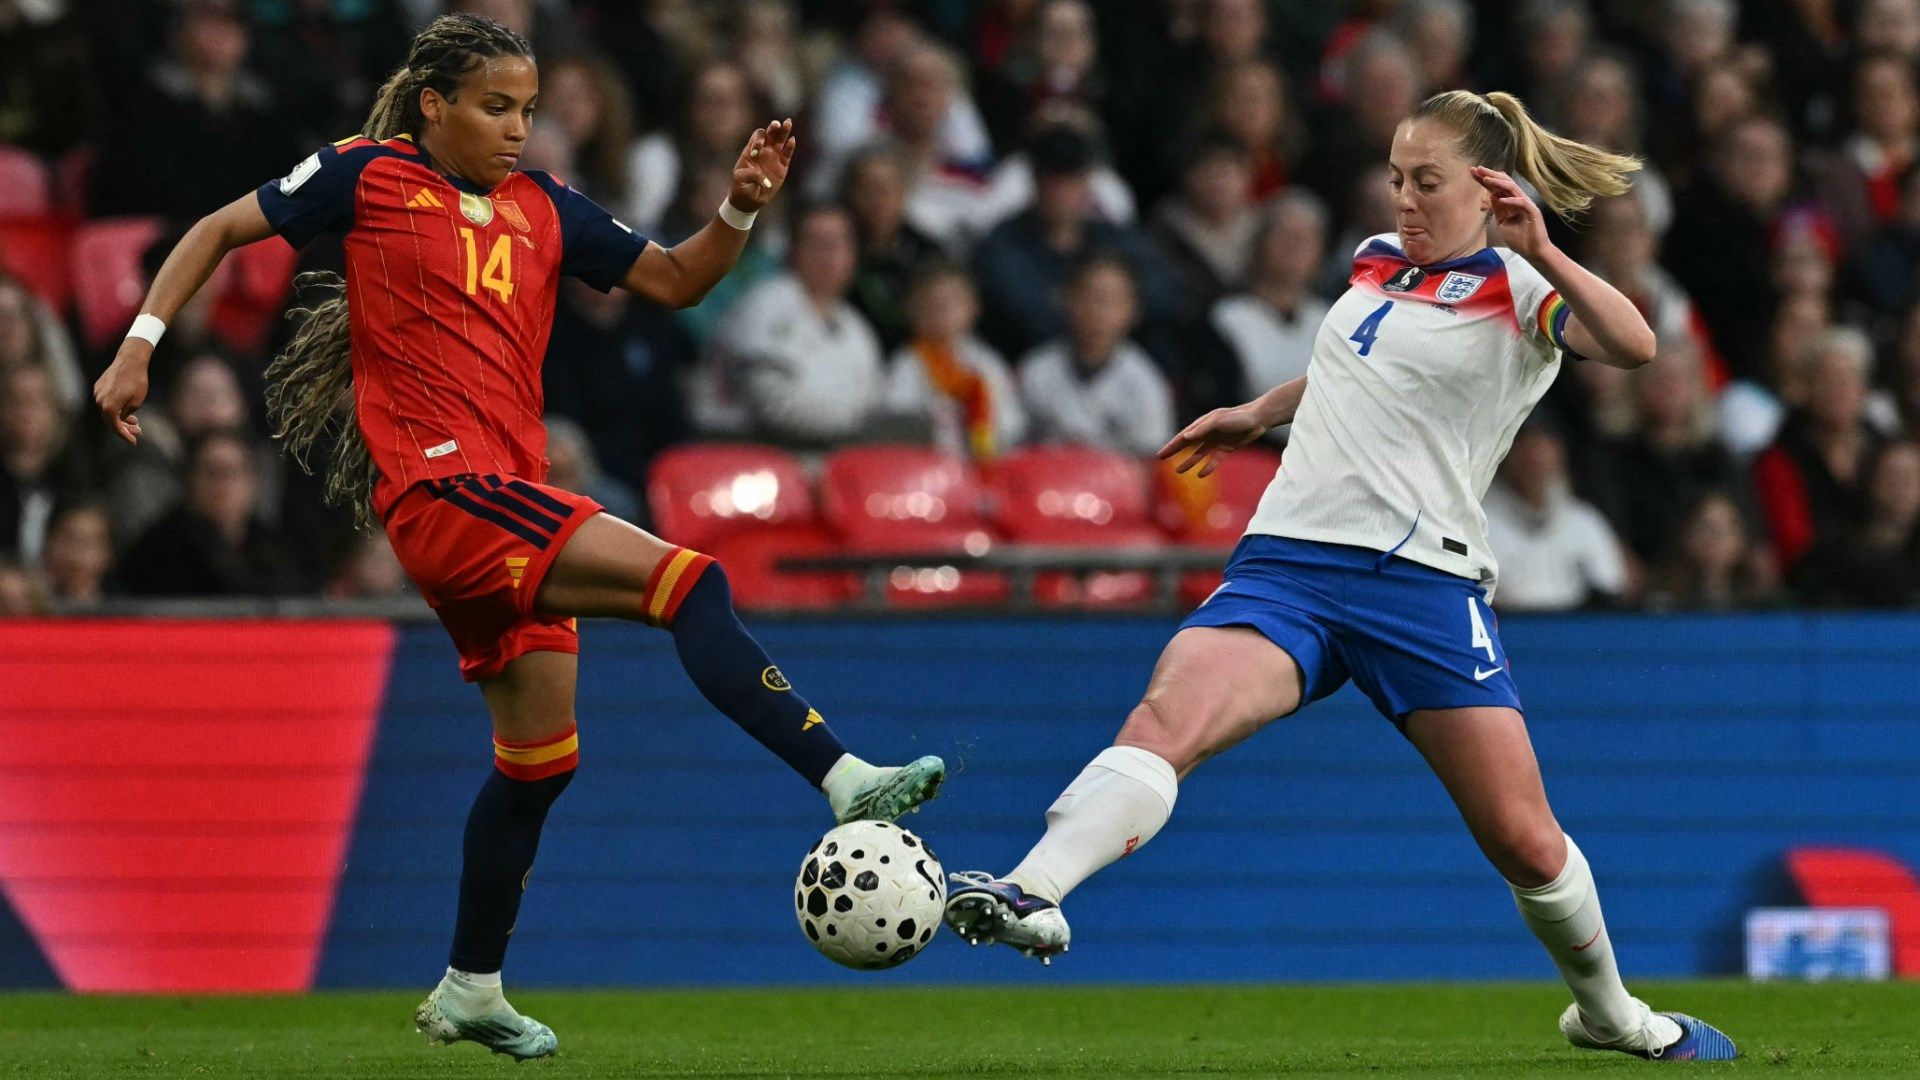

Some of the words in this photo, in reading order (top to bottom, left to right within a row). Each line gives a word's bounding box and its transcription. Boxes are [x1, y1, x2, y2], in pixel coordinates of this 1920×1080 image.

[460, 227, 514, 304] 14
[1349, 300, 1394, 356] 4
[1468, 597, 1496, 662] 4
